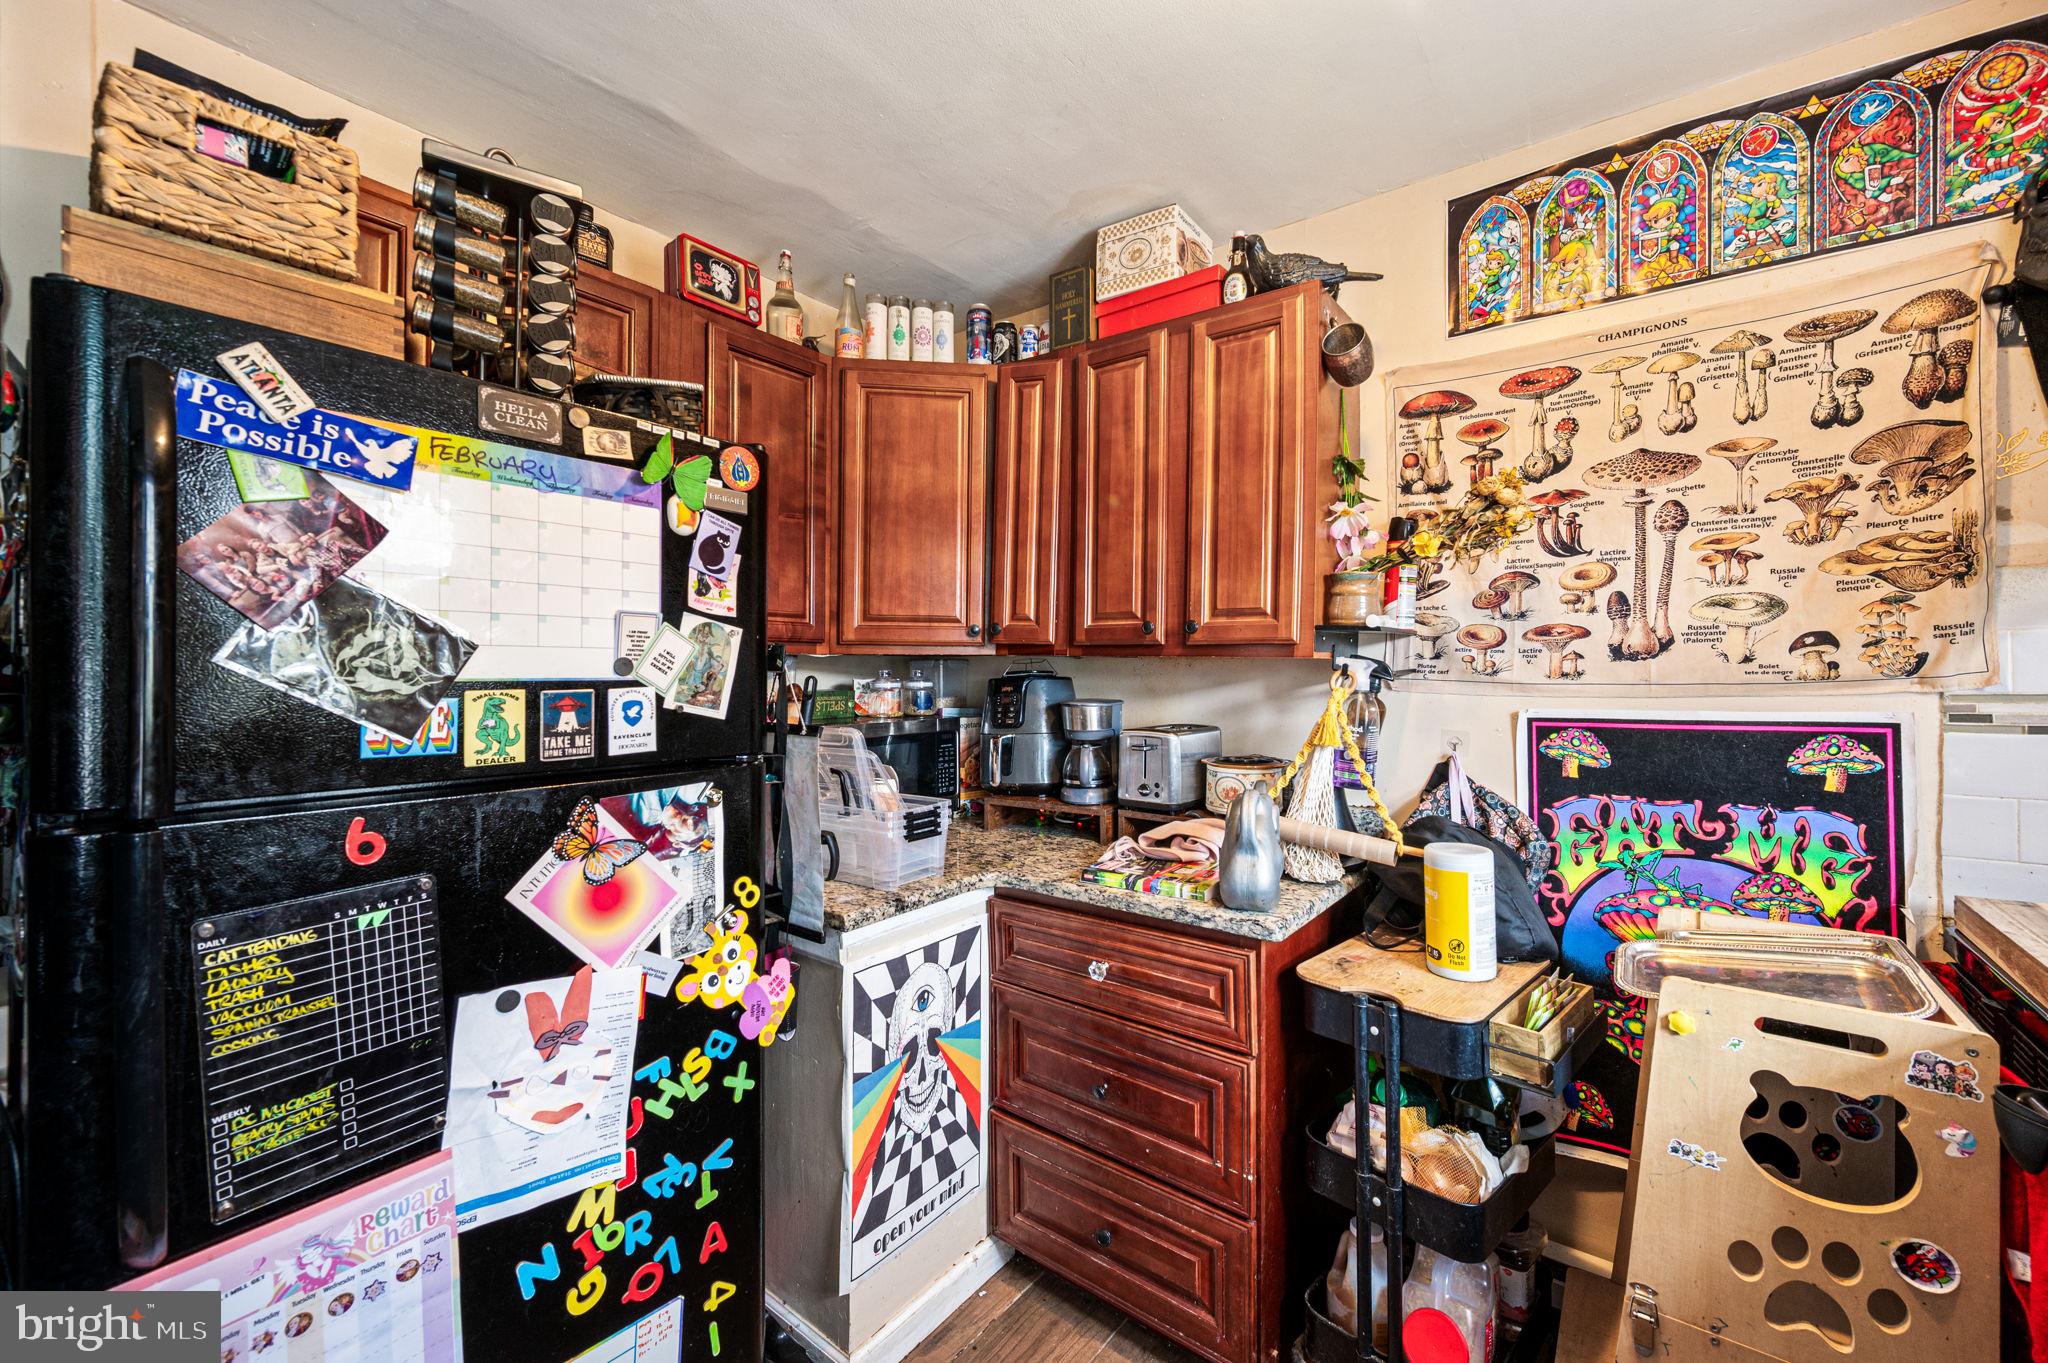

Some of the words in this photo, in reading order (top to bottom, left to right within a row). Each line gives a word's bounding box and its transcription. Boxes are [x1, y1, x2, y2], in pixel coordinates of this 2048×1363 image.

[1598, 317, 1688, 343] CHAMPIGNONS
[842, 342, 860, 352] RUM
[1660, 337, 1694, 349] Amanite
[1870, 333, 1913, 348] Amanite
[1651, 344, 1690, 358] phalloide
[1779, 344, 1818, 356] Amanite
[1854, 341, 1903, 359] (Grisette)
[1700, 354, 1736, 365] Amanite
[1777, 352, 1818, 366] panthere
[1779, 362, 1810, 373] fausse
[1696, 371, 1738, 384] (Grisette)
[228, 354, 297, 416] ATLANTA
[1622, 380, 1654, 392] Amanite
[1558, 389, 1588, 400] Amanite
[1625, 387, 1652, 397] citrine
[1550, 394, 1596, 407] tue-mouches
[494, 400, 548, 422] HELLA
[1458, 411, 1494, 421] Tricholome
[1494, 408, 1516, 416] ardent
[311, 414, 340, 440] is
[494, 412, 548, 432] CLEAN
[195, 408, 352, 468] Possible
[1756, 448, 1800, 459] Clitocybe
[430, 436, 558, 485] FEBRUARY
[1755, 455, 1800, 466] entonnoir
[1791, 453, 1846, 468] Chanterelle
[1792, 461, 1844, 474] comestible
[1797, 468, 1838, 480] (Girolle)
[1665, 484, 1706, 494] Souchette
[1398, 500, 1426, 508] Armillaire
[1569, 499, 1606, 510] Souchette
[1690, 516, 1740, 528] Chanterelle
[1866, 519, 1910, 530] Pleurote
[1911, 512, 1944, 524] huitre
[1696, 525, 1730, 535] (fausse
[1600, 548, 1627, 556] Lactire
[1770, 566, 1806, 576] Russule
[1778, 574, 1798, 582] jolie
[1836, 577, 1876, 587] Pleurote
[1836, 584, 1872, 593] conque
[1687, 623, 1720, 631] Russule
[1932, 621, 1976, 632] Russule
[1680, 630, 1727, 638] verdoyante
[1932, 630, 1958, 640] sans
[1959, 627, 1976, 638] lait
[1683, 637, 1723, 645] (Palomet)
[472, 691, 497, 702] SMALL
[498, 691, 520, 702] ARMS
[816, 700, 846, 712] SPELLS
[544, 736, 568, 748] TAKE
[574, 734, 592, 747] ME
[614, 732, 652, 740] RAVENCLAW
[544, 748, 564, 758] HOME
[564, 746, 592, 757] TONIGHT
[476, 755, 517, 766] DEALER
[345, 816, 387, 866] 6
[1543, 795, 1727, 910] EAT
[1714, 803, 1879, 924] ME
[733, 875, 762, 909] 8
[348, 908, 358, 916] M
[378, 901, 388, 909] W
[197, 937, 227, 950] DAILY
[207, 954, 282, 981] DISHES
[207, 967, 295, 998] LAUNDRY
[205, 986, 264, 1011] TRASH
[704, 1029, 738, 1060] B
[634, 1056, 671, 1084] F
[682, 1047, 712, 1084] S
[211, 1104, 252, 1124] WEEKLY
[360, 1177, 450, 1235] Reward
[873, 1217, 907, 1256] open
[908, 1198, 938, 1234] your
[939, 1169, 966, 1209] mind
[367, 1206, 438, 1253] Chart
[625, 1210, 652, 1256] R
[700, 1221, 728, 1265] A
[221, 1328, 241, 1343] unday
[253, 1310, 280, 1327] Monday
[292, 1292, 316, 1308] Tuesday
[323, 1274, 356, 1294] Wednesday
[360, 1260, 386, 1276] Thursday
[396, 1247, 414, 1259] Friday
[423, 1231, 446, 1246] Saturday
